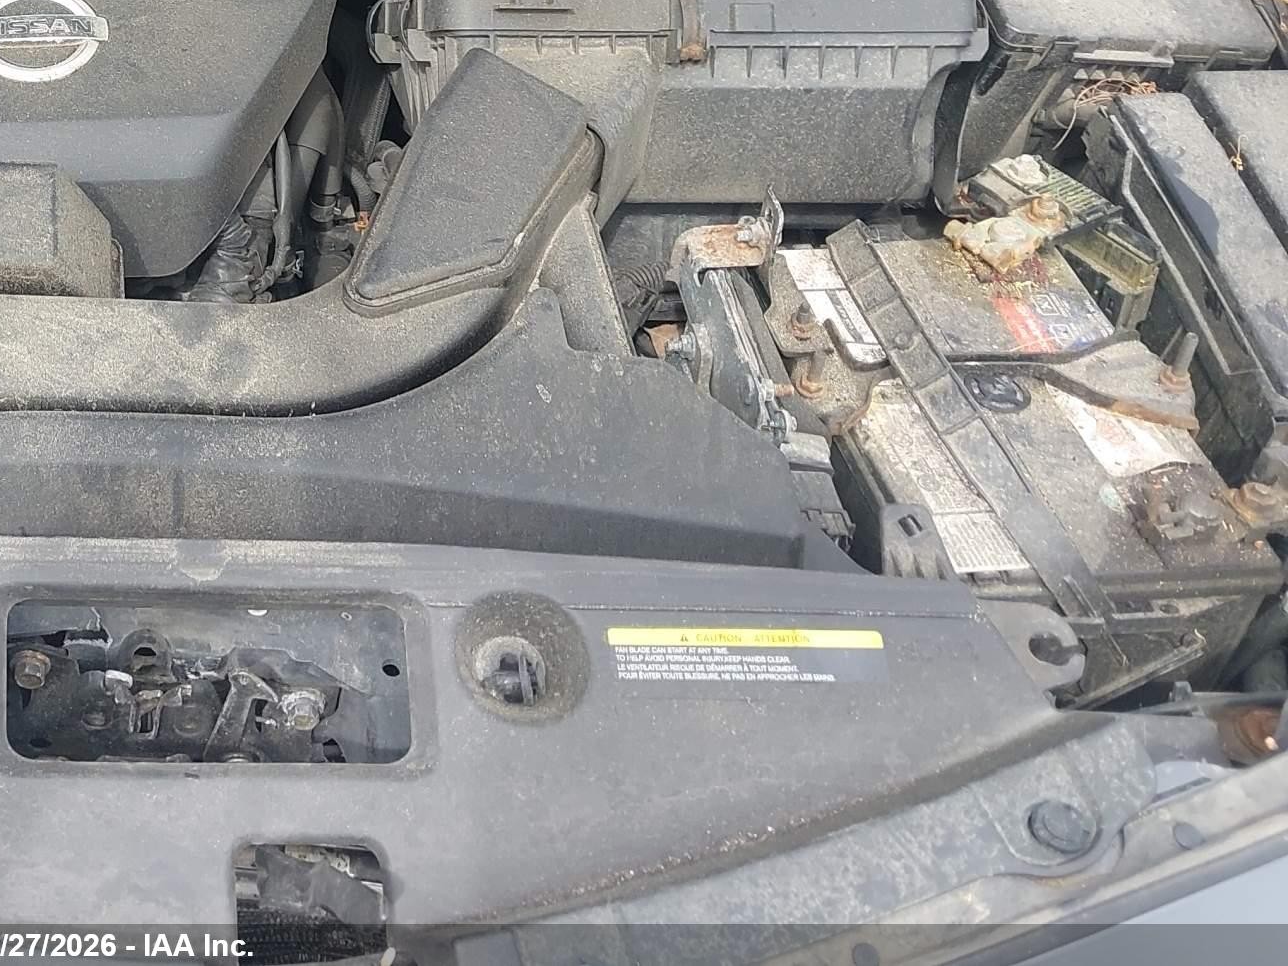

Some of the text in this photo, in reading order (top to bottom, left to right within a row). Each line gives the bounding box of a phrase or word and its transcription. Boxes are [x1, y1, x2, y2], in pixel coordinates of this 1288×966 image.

[695, 634, 742, 643] CAUTION
[754, 634, 810, 644] ATTENTION
[644, 654, 665, 662] AVOID
